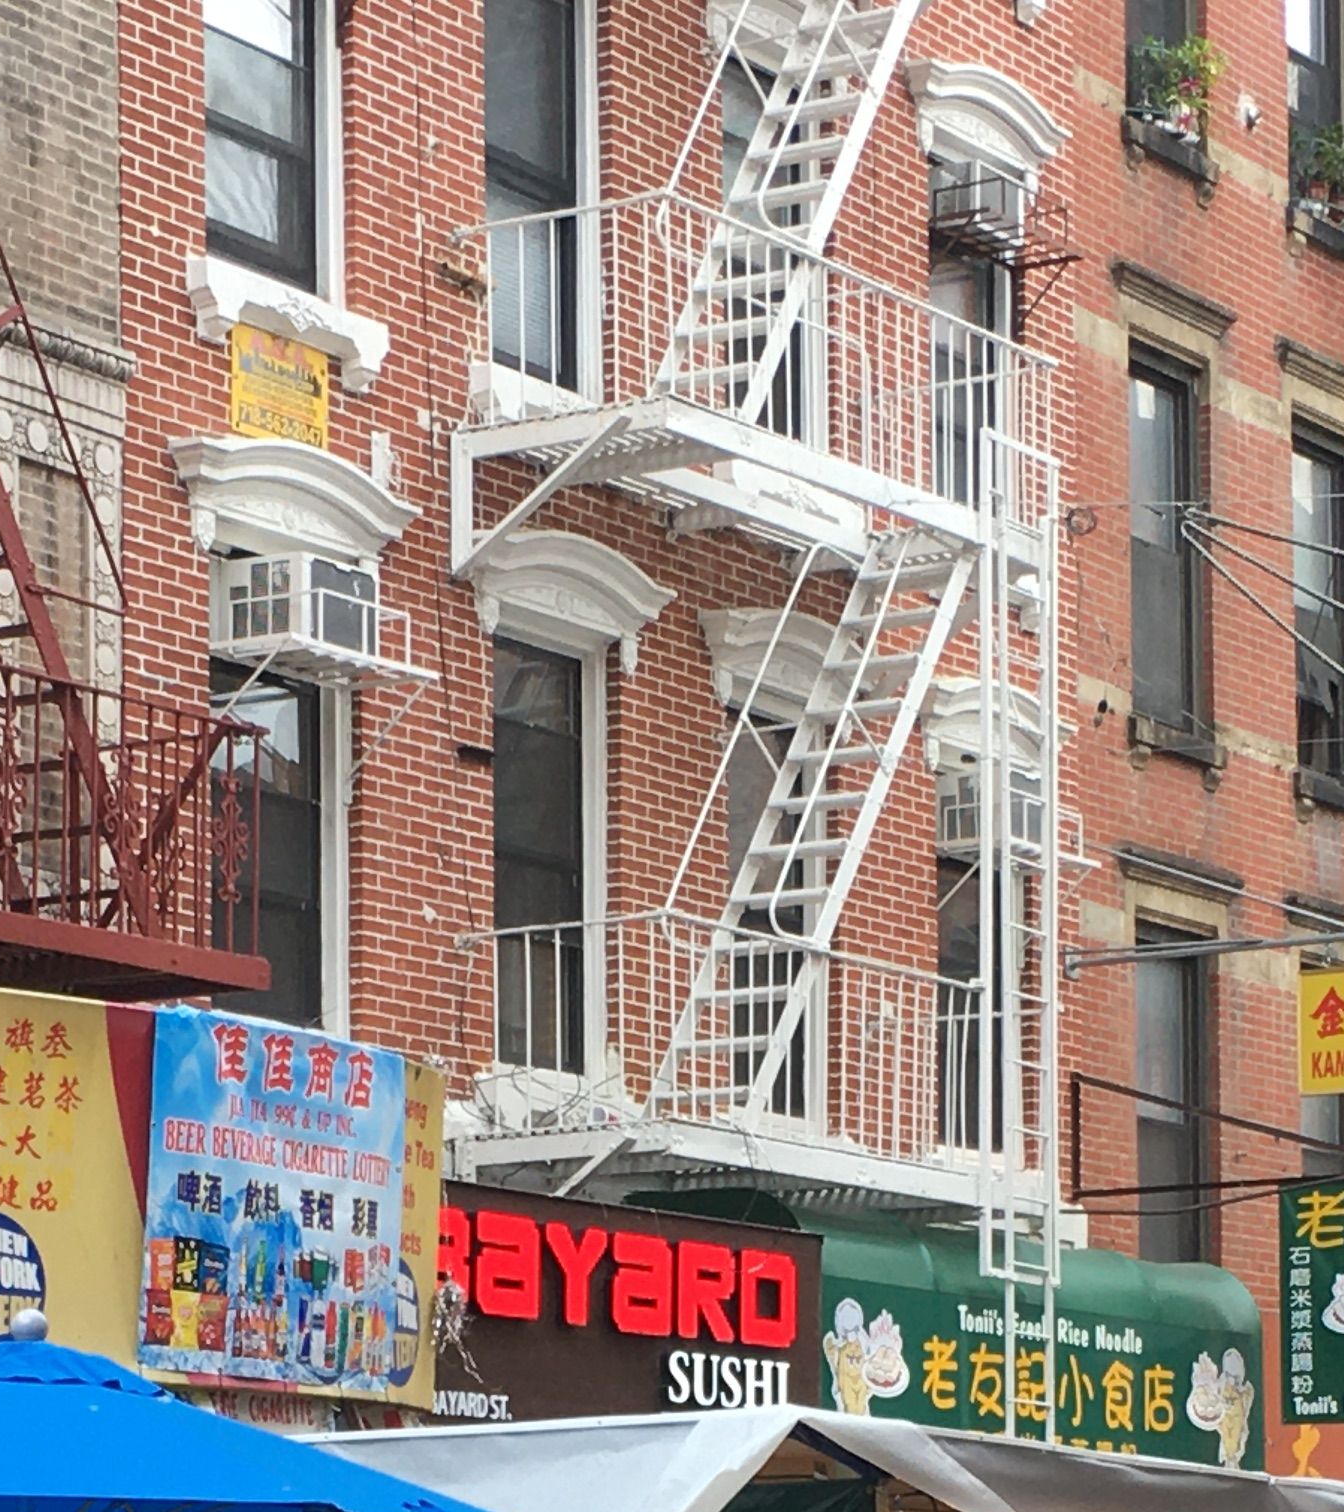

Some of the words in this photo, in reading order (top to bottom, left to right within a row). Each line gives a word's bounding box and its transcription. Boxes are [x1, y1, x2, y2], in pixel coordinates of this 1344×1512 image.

[165, 1119, 206, 1155] BEER
[212, 1125, 276, 1168] BEVERAGE
[282, 1138, 348, 1179] CIGARETTE
[415, 1139, 435, 1171] Tea
[177, 1170, 223, 1215] 啤酒
[958, 1304, 1004, 1334] Tonii's
[1057, 1317, 1090, 1349] Rice
[1095, 1323, 1143, 1355] Noodle
[667, 1350, 791, 1409] SUSHI
[922, 1334, 1176, 1433] 老友記小食店
[490, 1394, 513, 1421] ST.
[1292, 1396, 1339, 1416] Tonii's
